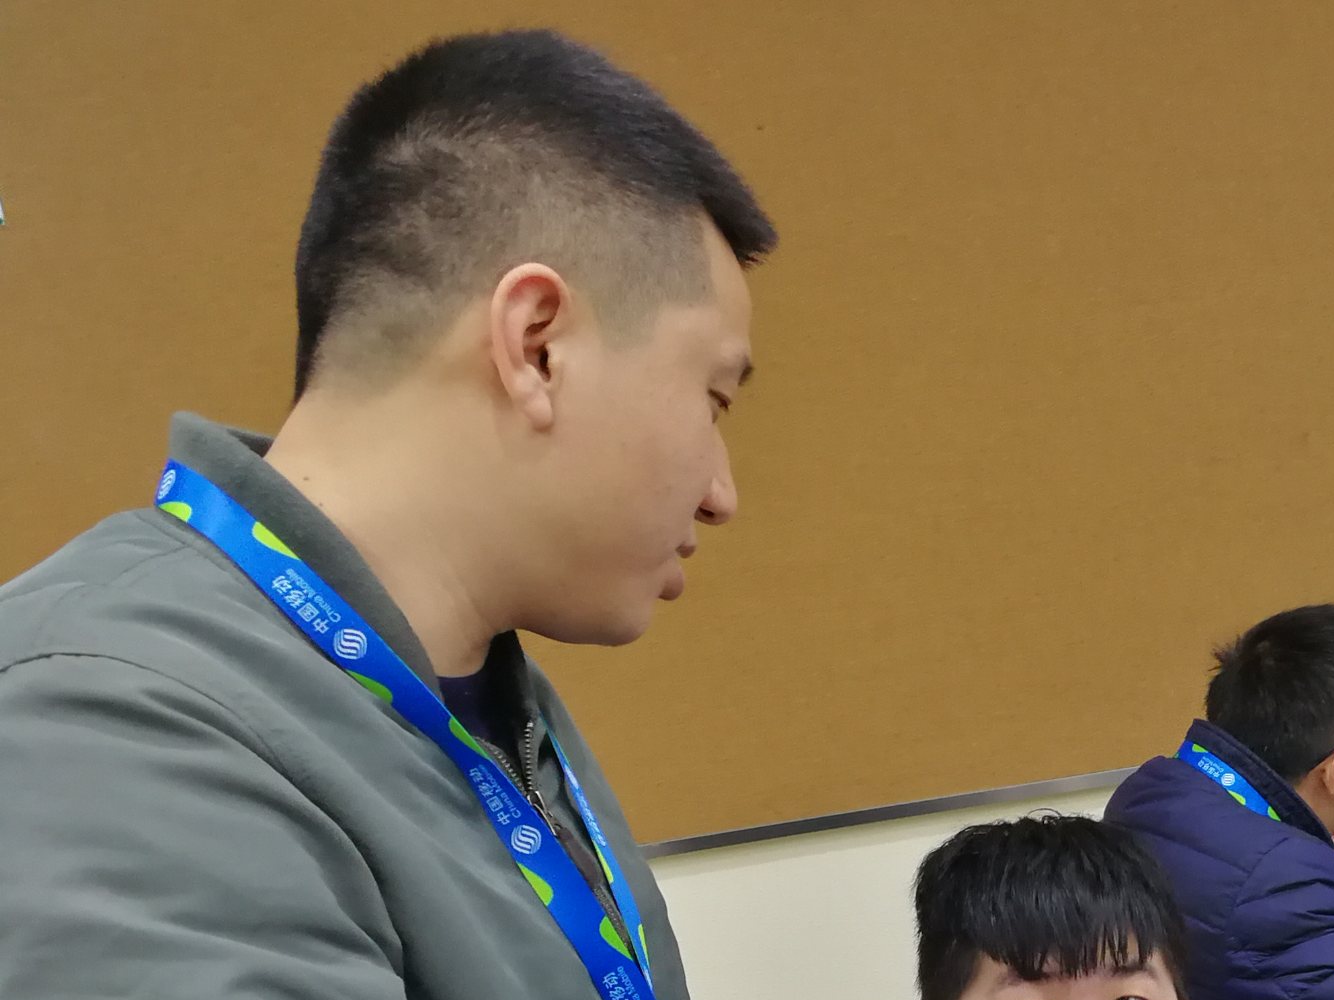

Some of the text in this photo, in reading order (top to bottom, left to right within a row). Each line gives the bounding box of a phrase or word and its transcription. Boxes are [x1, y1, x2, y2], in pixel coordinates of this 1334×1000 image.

[272, 576, 330, 634] 中国移动
[469, 767, 511, 825] 中国移动
